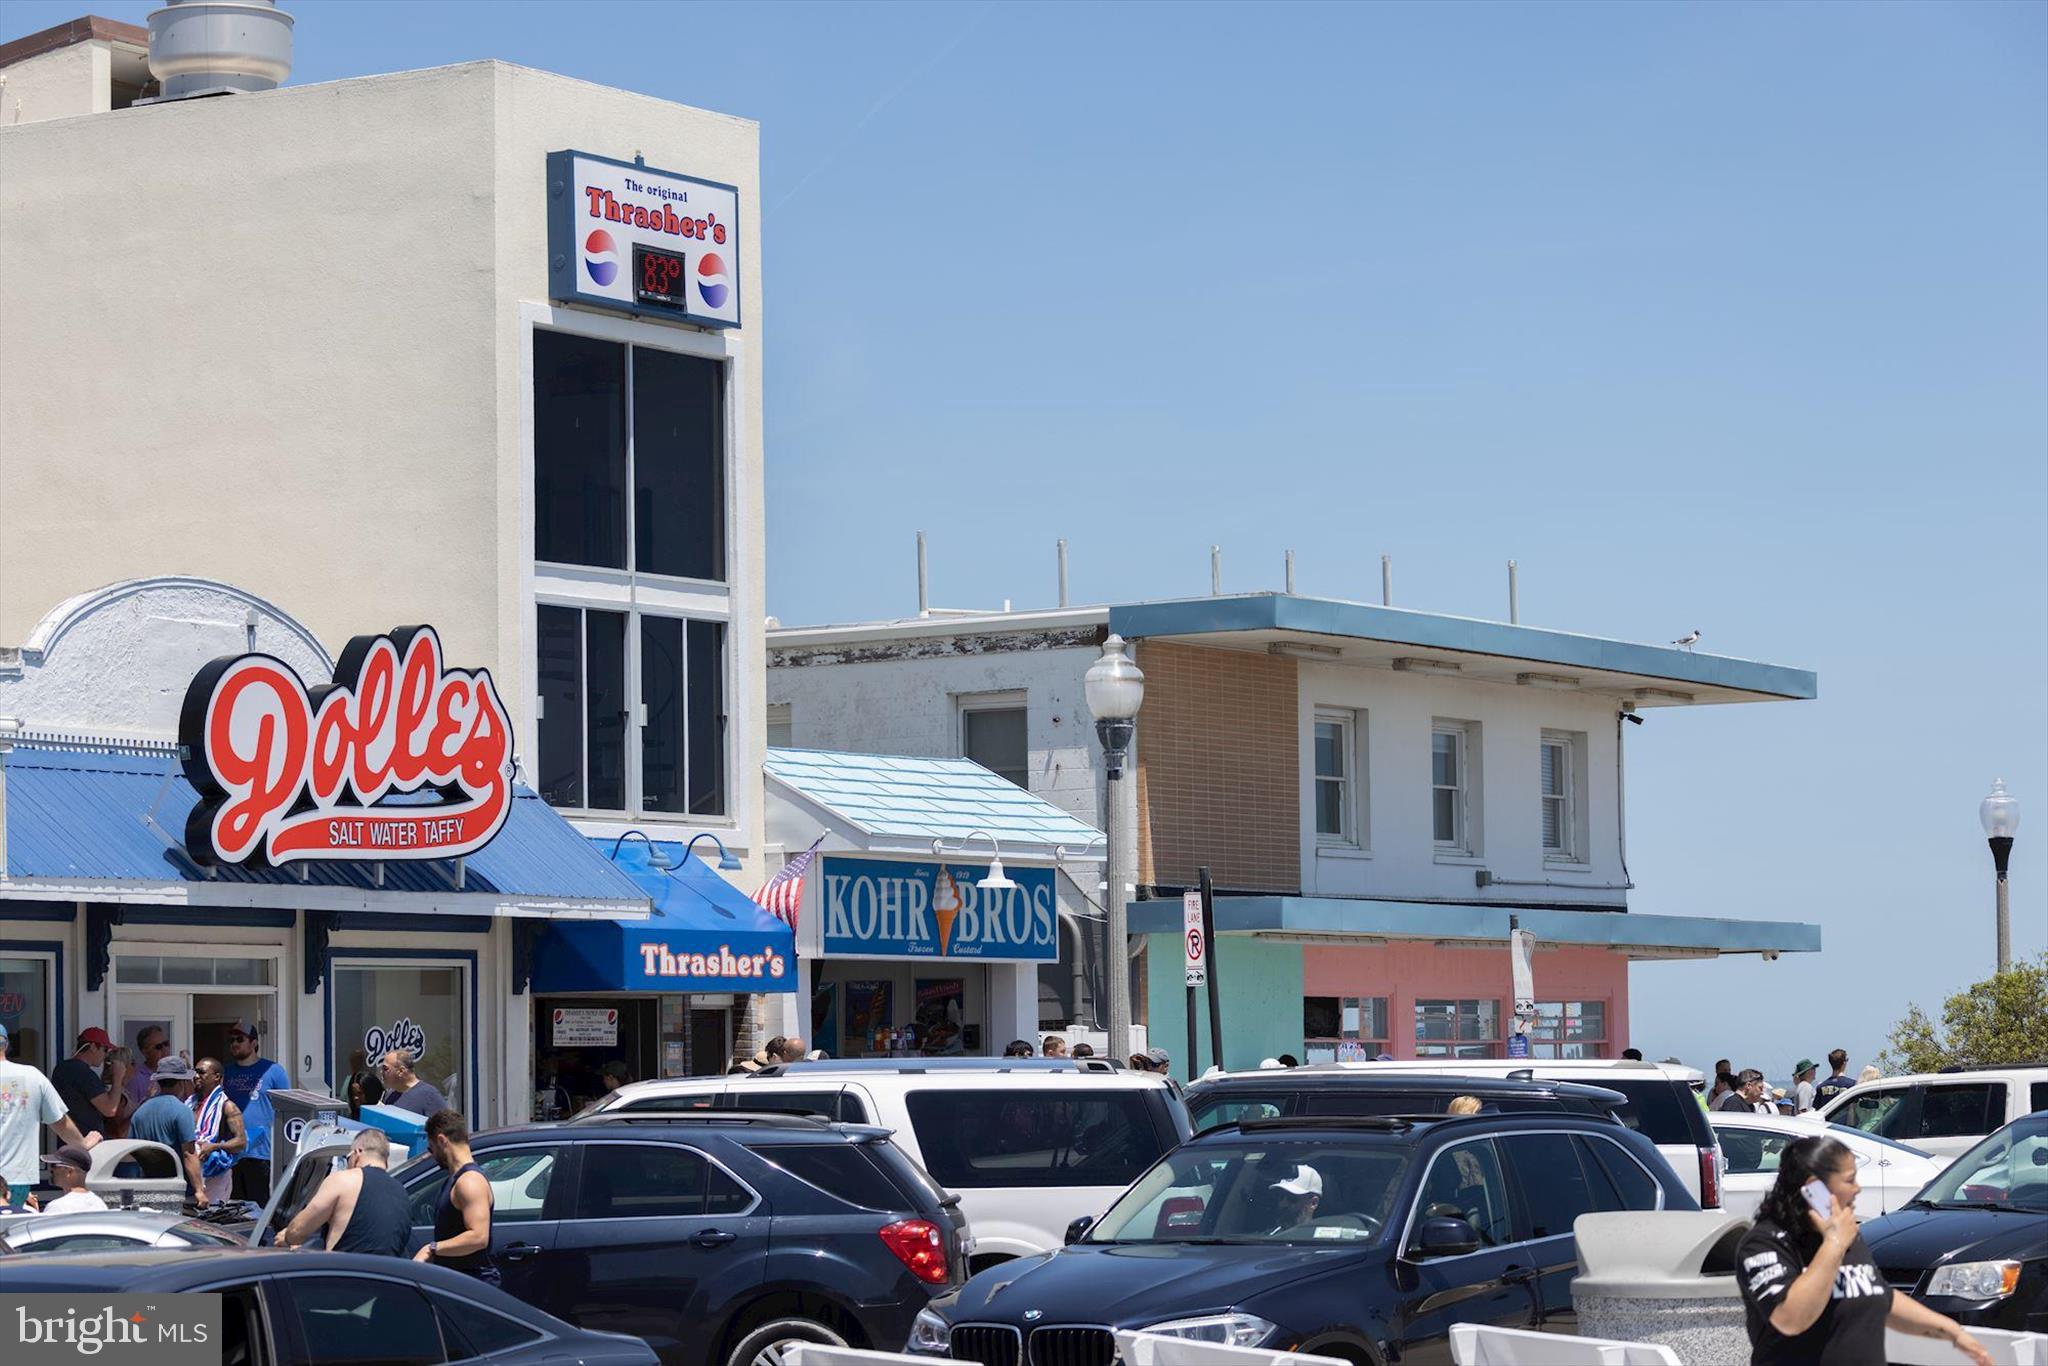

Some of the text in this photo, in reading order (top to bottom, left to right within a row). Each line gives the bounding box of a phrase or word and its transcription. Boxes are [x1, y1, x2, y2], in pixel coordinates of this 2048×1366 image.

[625, 178, 688, 204] The original
[585, 186, 727, 245] Thrasher's
[328, 818, 465, 847] SALT WATER TAFFY
[825, 874, 930, 941] KOHR
[1187, 899, 1200, 911] FIRE
[1187, 912, 1201, 924] LANE
[640, 943, 785, 978] Thrasher's
[907, 941, 982, 955] Frozen Custard
[304, 1055, 313, 1073] 9
